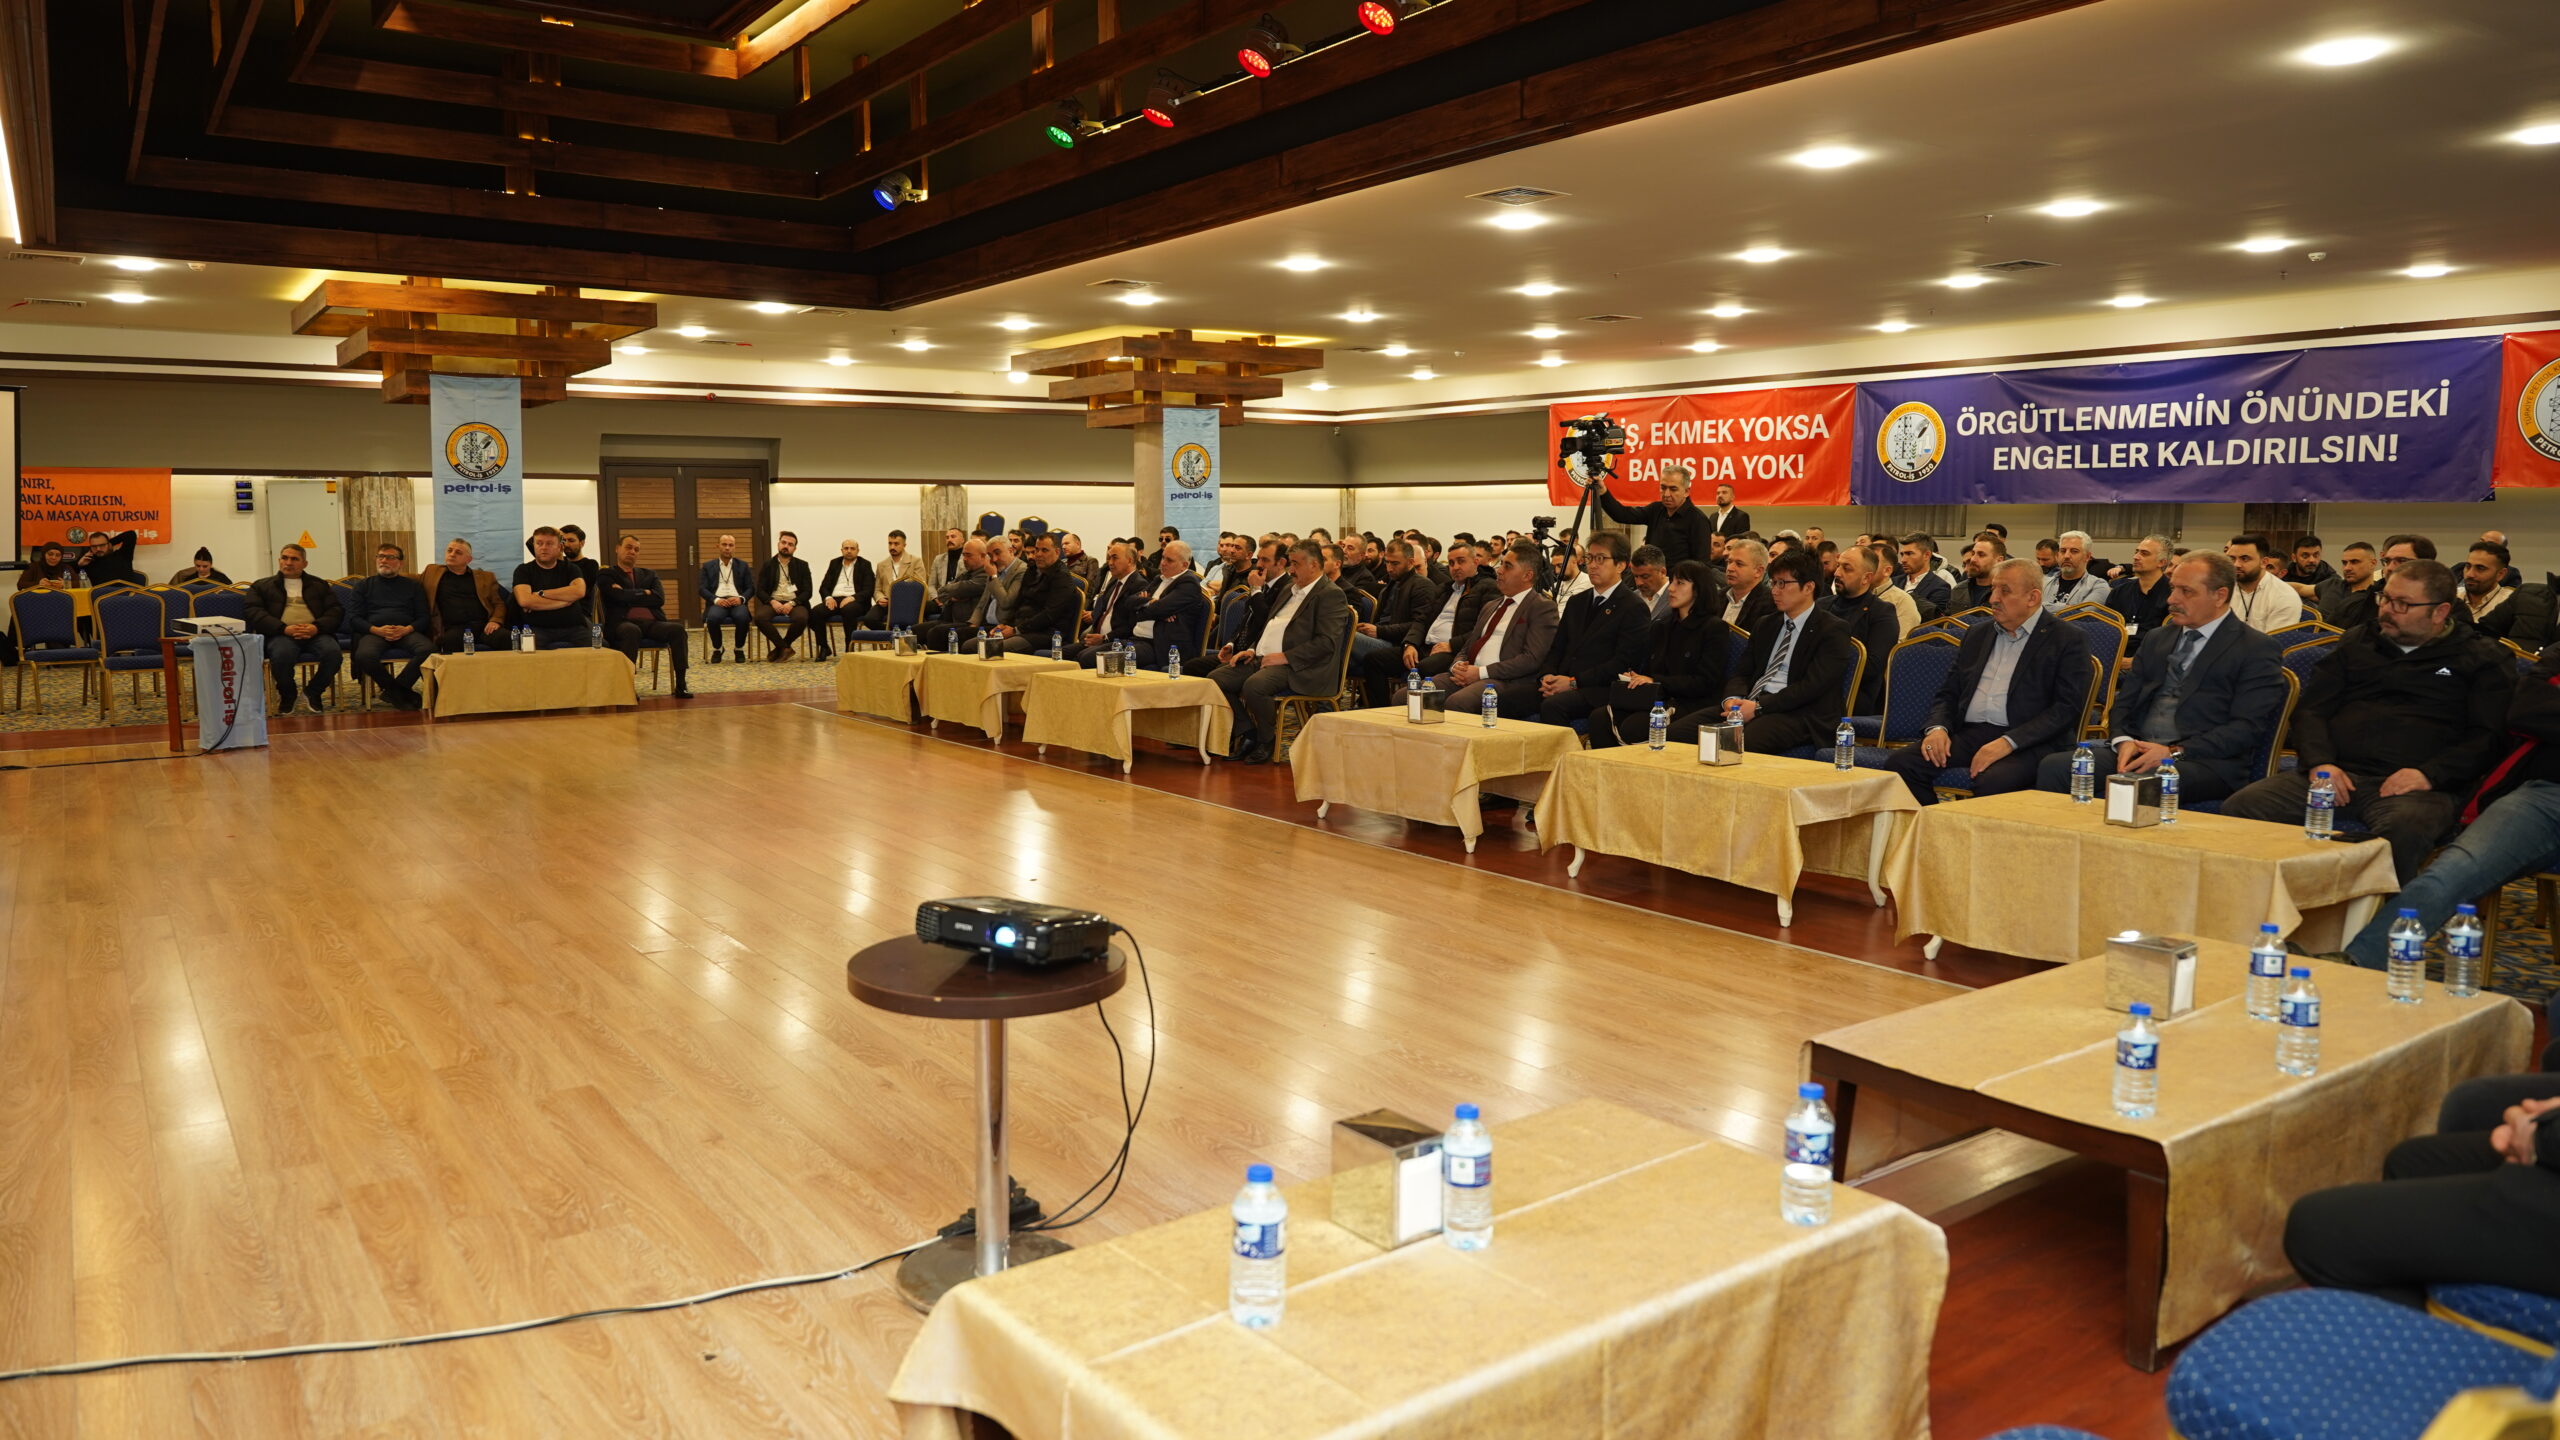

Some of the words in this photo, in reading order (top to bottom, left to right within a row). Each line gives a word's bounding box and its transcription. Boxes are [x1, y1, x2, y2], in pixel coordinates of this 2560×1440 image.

[1956, 393, 2231, 437] ÖRGÜTLENMENİN
[2240, 379, 2450, 425] ÖNÜNDEKİ
[1620, 417, 1645, 454] Ş,
[1650, 418, 1735, 446] EKMEK
[1738, 413, 1830, 442] YOKSA
[1993, 442, 2149, 471] ENGELLER
[2157, 433, 2399, 467] KALDIRILSIN!
[1629, 457, 1697, 487] BAŞ
[1702, 456, 1736, 481] DA
[1741, 454, 1804, 480] YOK!
[1918, 463, 1934, 477] 1950
[443, 483, 512, 495] petrol-iş
[1170, 491, 1213, 501] petrol-iş
[45, 494, 126, 507] KALDIRILSIN,
[47, 510, 99, 521] MASAYA
[102, 509, 159, 521] OTURSUN!
